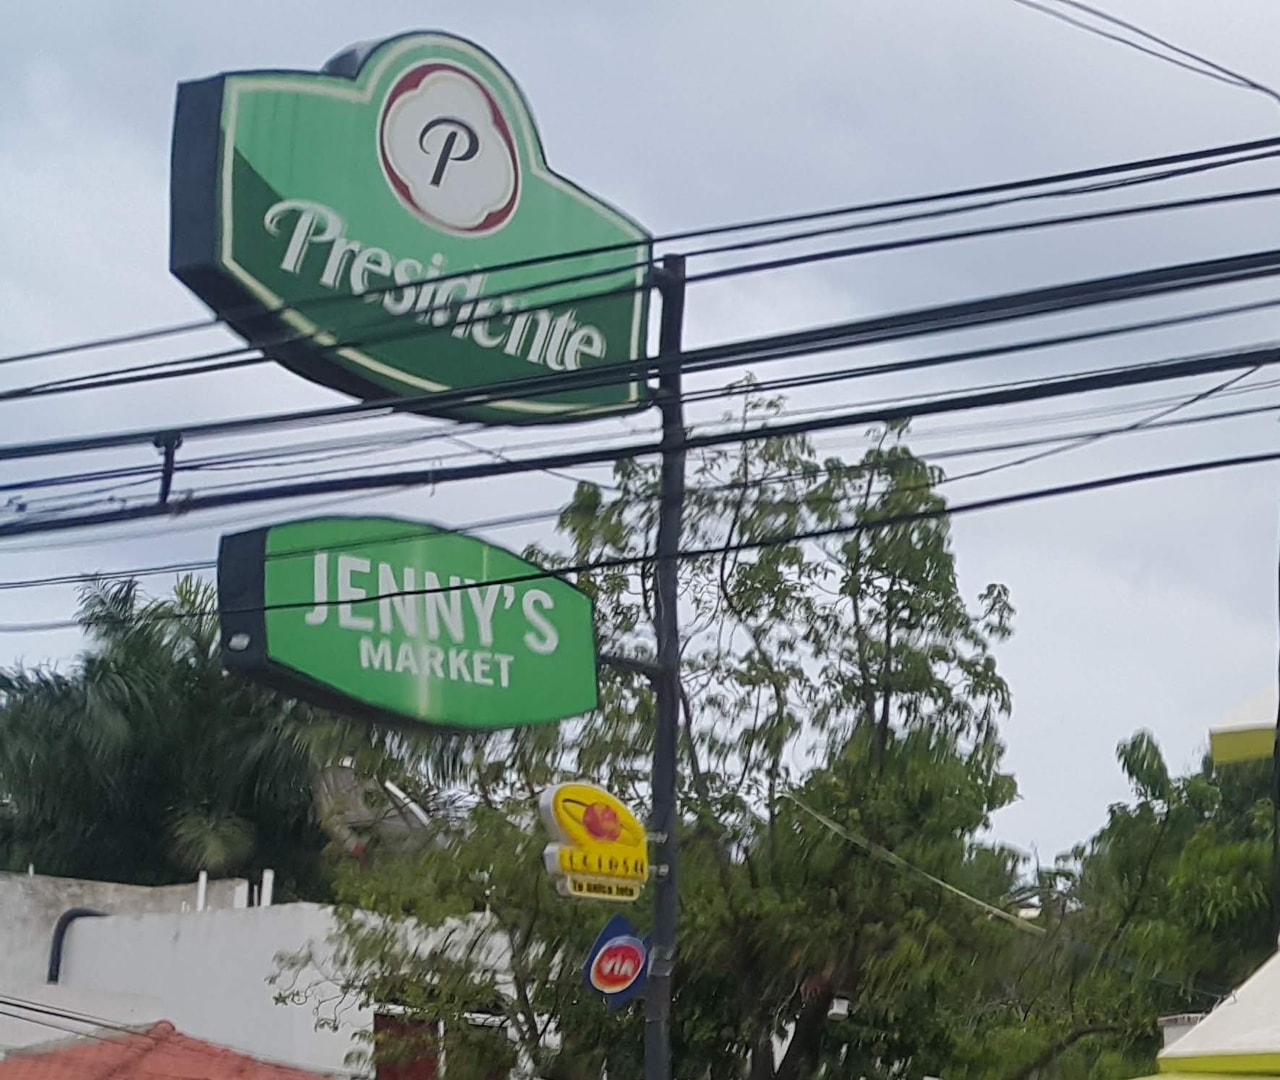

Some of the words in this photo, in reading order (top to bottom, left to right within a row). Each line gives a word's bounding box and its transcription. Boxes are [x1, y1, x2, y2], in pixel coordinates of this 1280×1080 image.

[419, 116, 479, 188] P
[264, 197, 608, 373] Presidente
[304, 551, 559, 656] JENNY'S
[359, 636, 515, 689] MARKET
